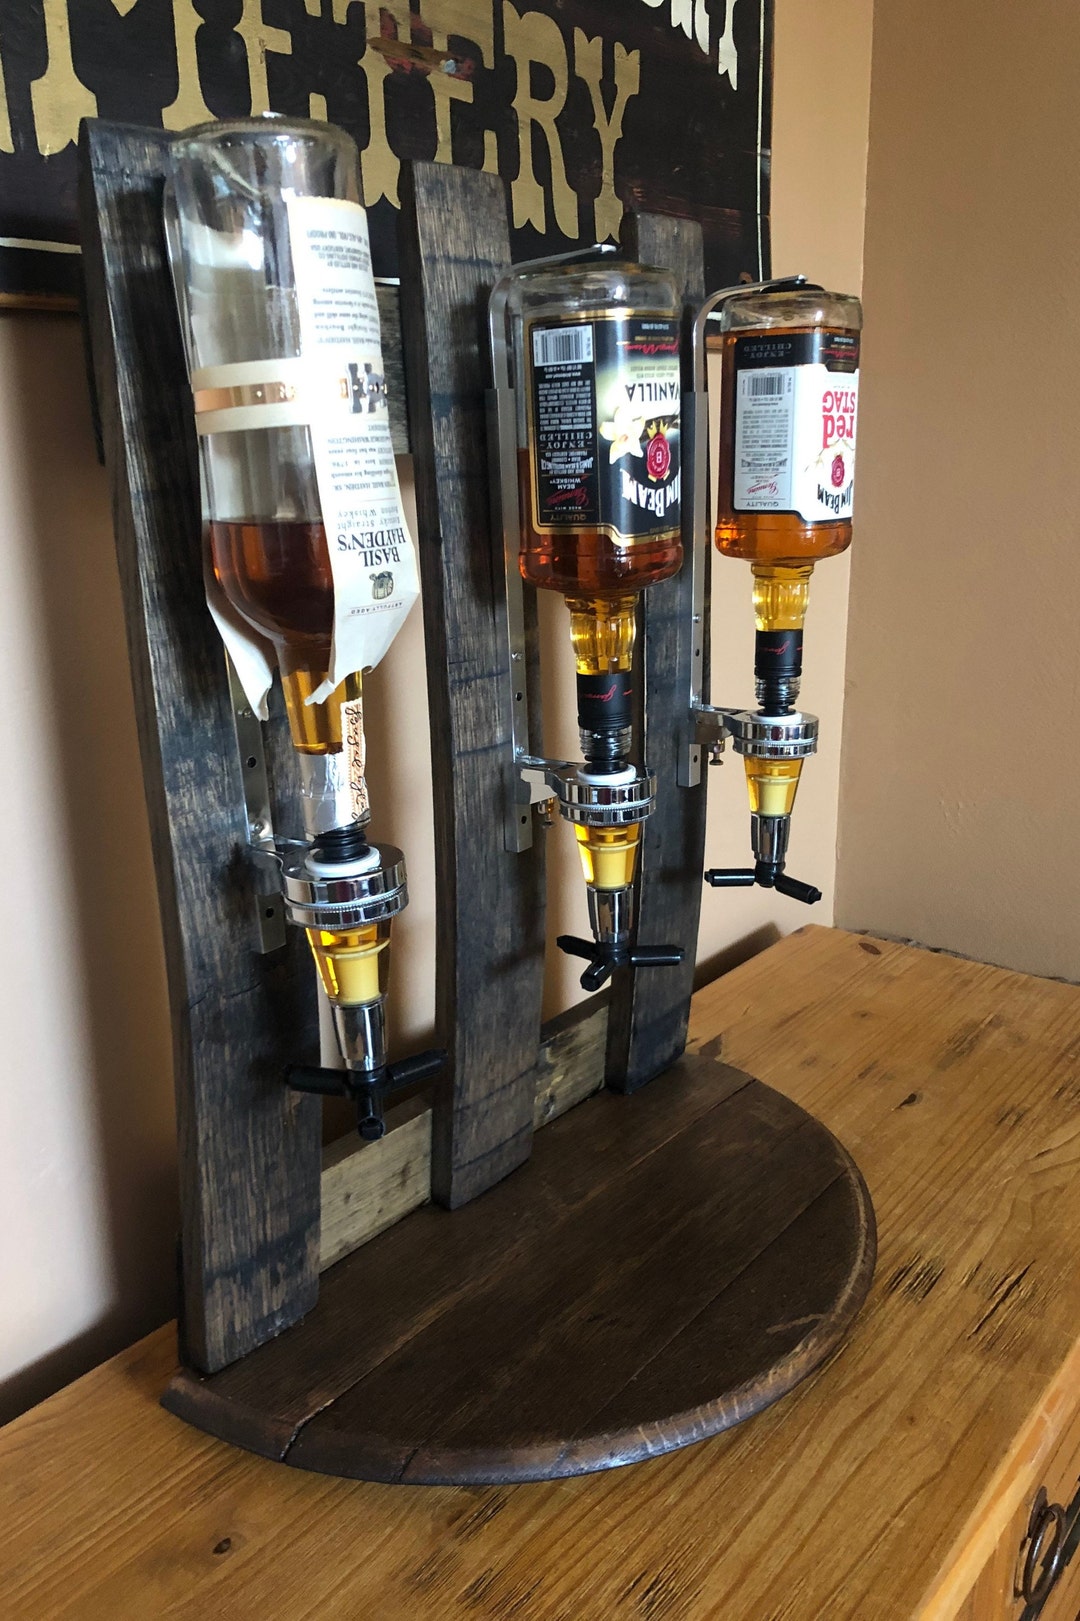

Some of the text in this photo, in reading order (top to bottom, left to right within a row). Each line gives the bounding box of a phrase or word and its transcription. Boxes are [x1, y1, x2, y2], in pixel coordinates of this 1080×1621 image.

[625, 382, 681, 402] VANILLA
[822, 390, 856, 413] STAG
[539, 431, 593, 442] CHILLED
[822, 414, 854, 449] red
[545, 440, 585, 450] ENJOY
[619, 468, 665, 518] BEAM
[817, 483, 841, 515] BEAM
[337, 527, 407, 552] HAYDEN'S
[358, 546, 401, 567] BASIL
